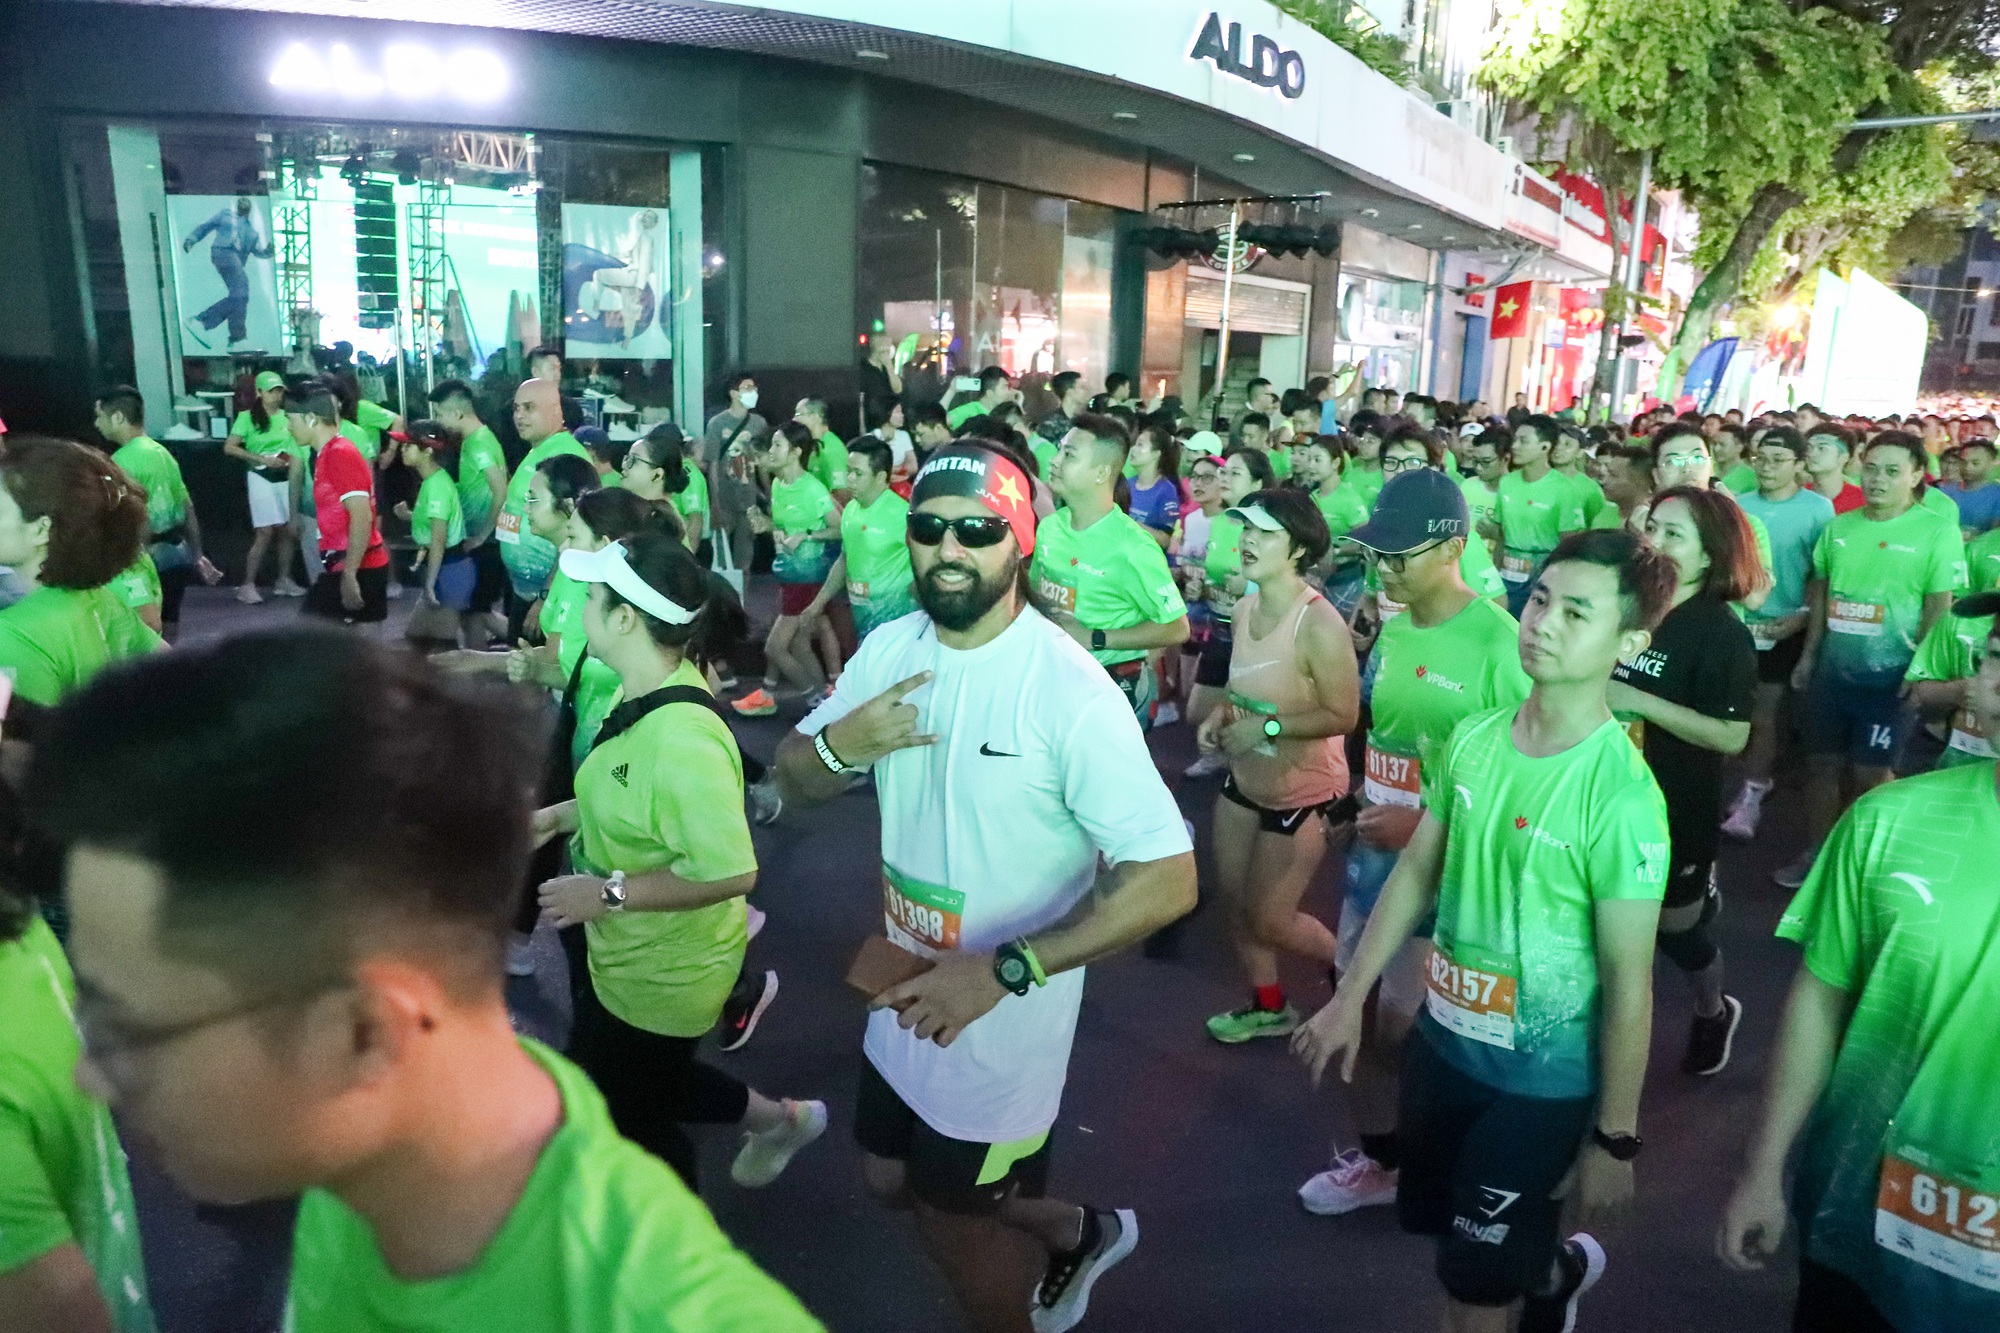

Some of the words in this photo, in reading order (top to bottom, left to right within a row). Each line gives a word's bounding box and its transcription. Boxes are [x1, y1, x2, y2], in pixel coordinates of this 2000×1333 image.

[269, 42, 508, 98] ALDO
[1189, 11, 1305, 99] ALDO
[1426, 671, 1464, 693] VPBank
[1623, 655, 1665, 678] ANCE
[1869, 723, 1892, 750] 14
[611, 769, 629, 788] adidas
[1369, 749, 1410, 783] 61137
[889, 884, 944, 943] 61398
[1431, 951, 1498, 1006] 62157
[1911, 1173, 2000, 1238] 612
